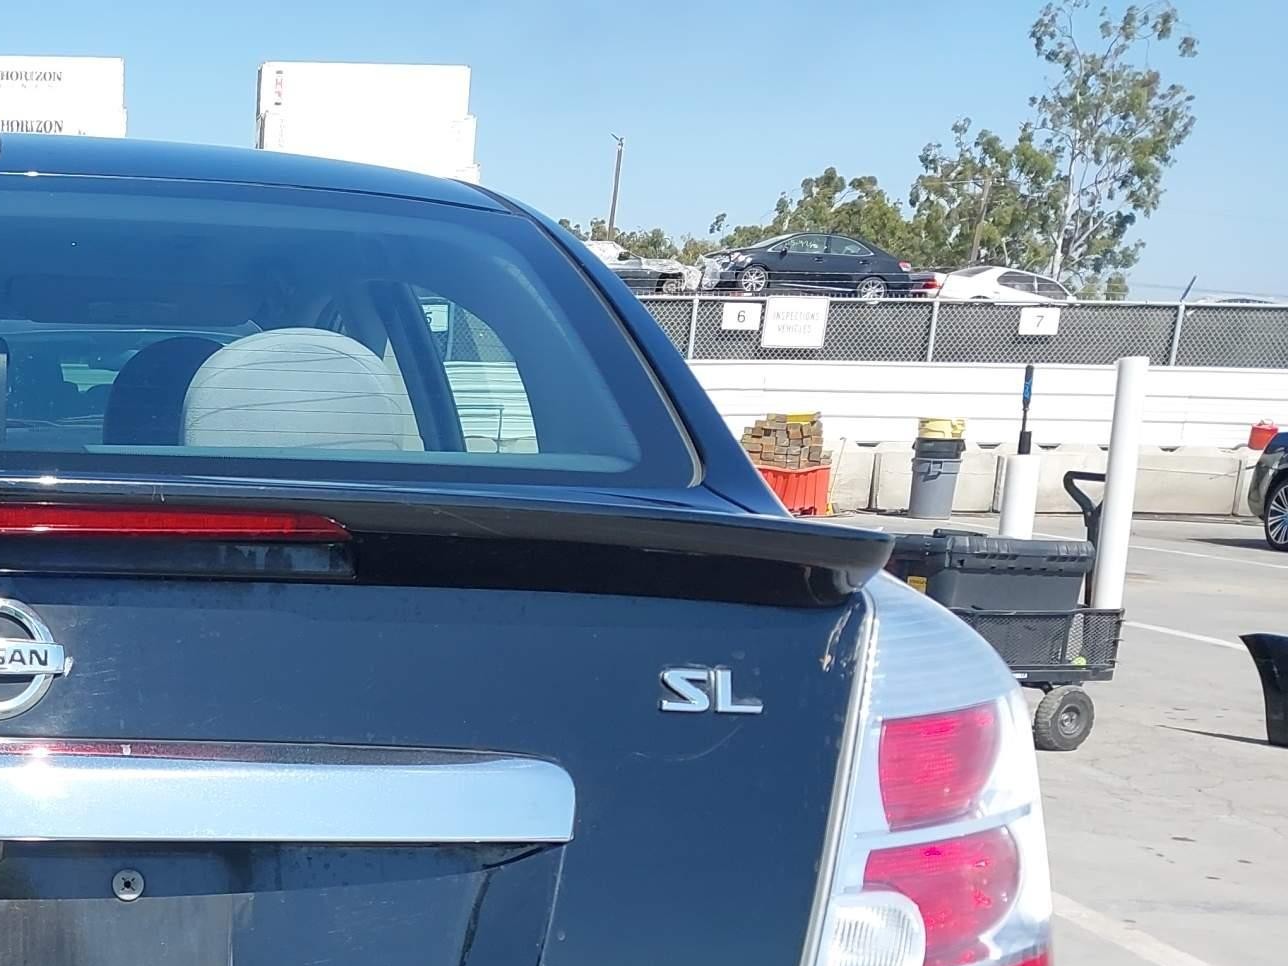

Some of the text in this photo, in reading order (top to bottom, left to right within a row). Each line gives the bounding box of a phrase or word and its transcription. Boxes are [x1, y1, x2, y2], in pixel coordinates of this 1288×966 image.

[0, 70, 62, 82] HORIZON
[0, 119, 63, 134] HORIZON
[424, 311, 433, 325] 5
[737, 310, 746, 323] 6
[1036, 315, 1045, 328] 7
[660, 667, 764, 713] SL
